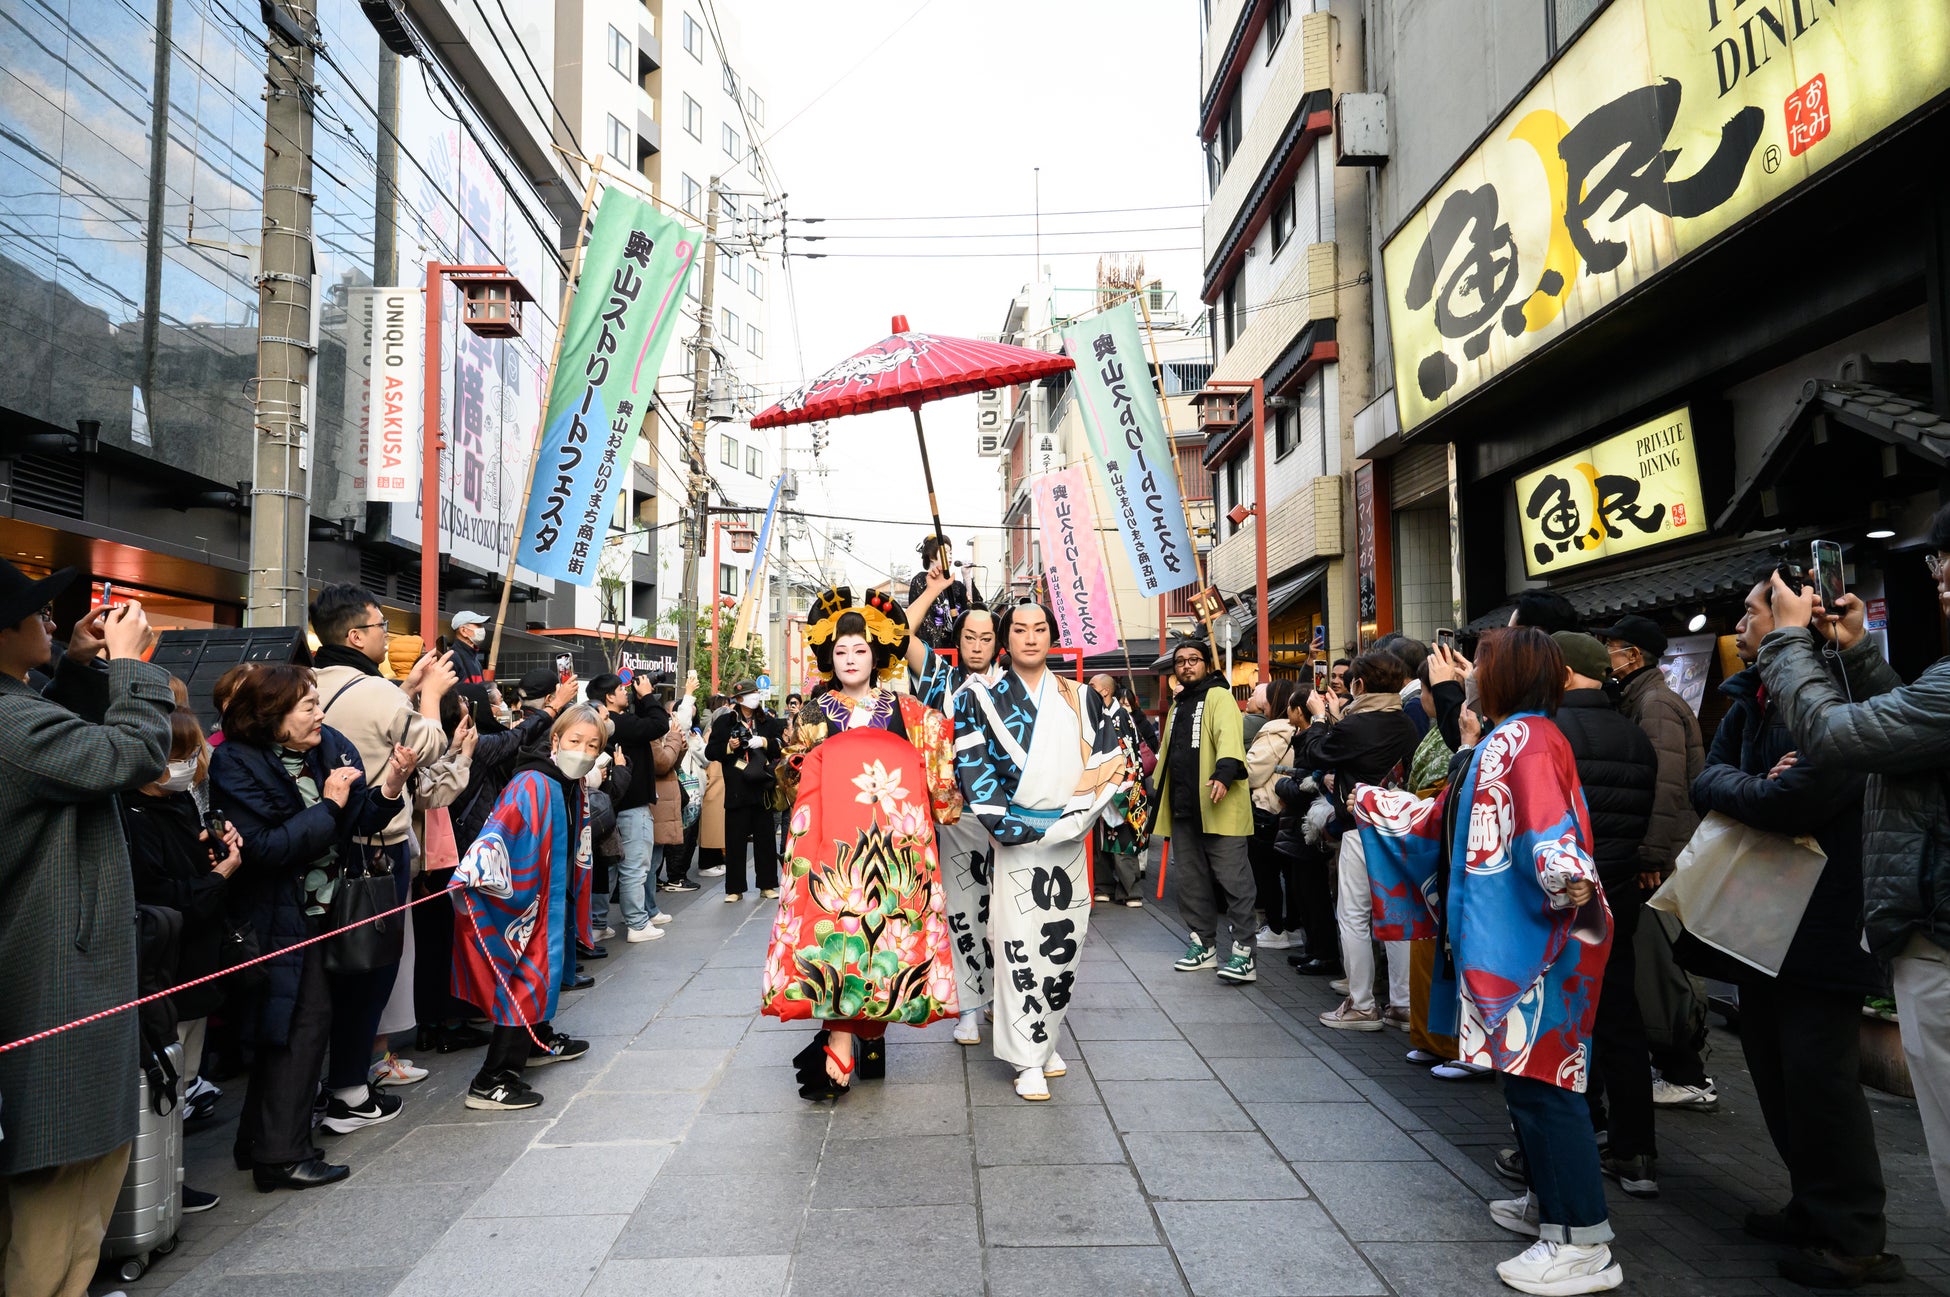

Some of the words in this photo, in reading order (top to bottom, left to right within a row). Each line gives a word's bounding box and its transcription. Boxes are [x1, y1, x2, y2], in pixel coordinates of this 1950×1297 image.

[1405, 76, 1765, 401] 魚民
[382, 297, 404, 367] UNIQLO
[381, 376, 404, 468] ASAKUSA
[534, 230, 655, 554] 奥山ストリートフェスタ
[1636, 422, 1685, 457] PRIVATE
[1639, 448, 1681, 479] DINING
[567, 400, 633, 575] 奥山おまいりまち商店街
[1526, 474, 1666, 565] 魚民
[622, 651, 664, 671] Richmond
[1031, 865, 1077, 1011] いろは
